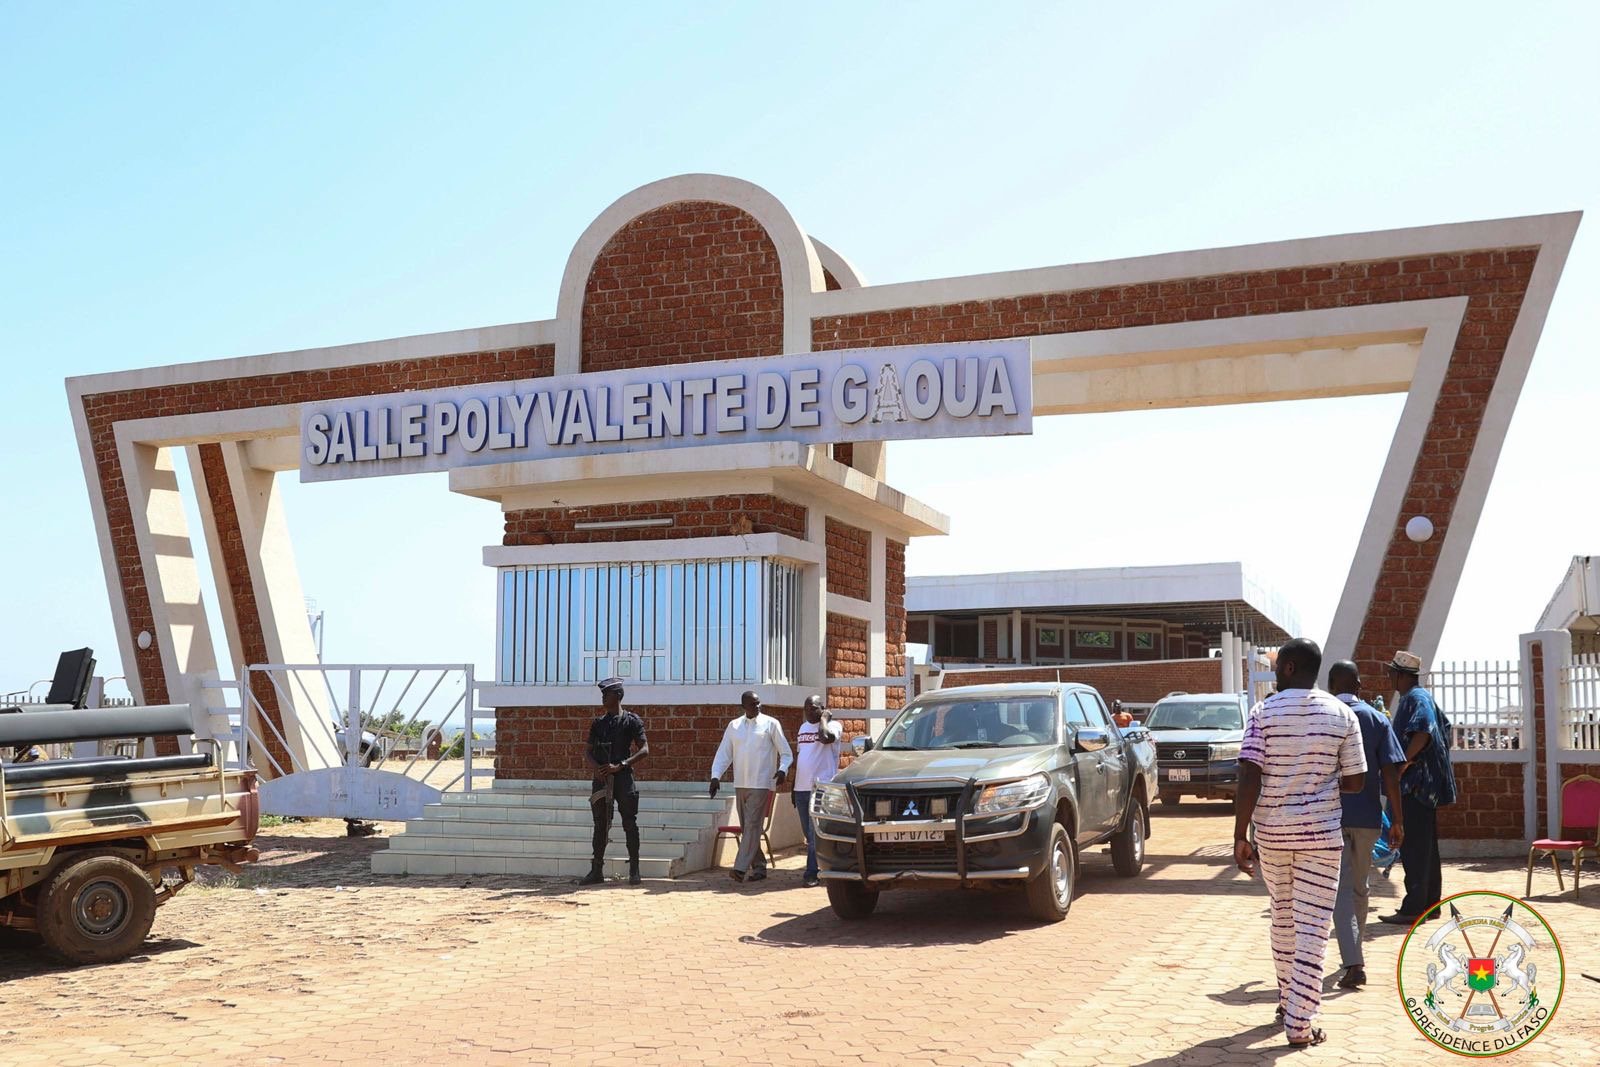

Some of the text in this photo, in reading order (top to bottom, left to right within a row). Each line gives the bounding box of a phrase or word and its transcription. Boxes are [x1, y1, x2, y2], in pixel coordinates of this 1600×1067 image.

[305, 356, 1018, 466] SALLE POLYVALENTE DE GAOUA
